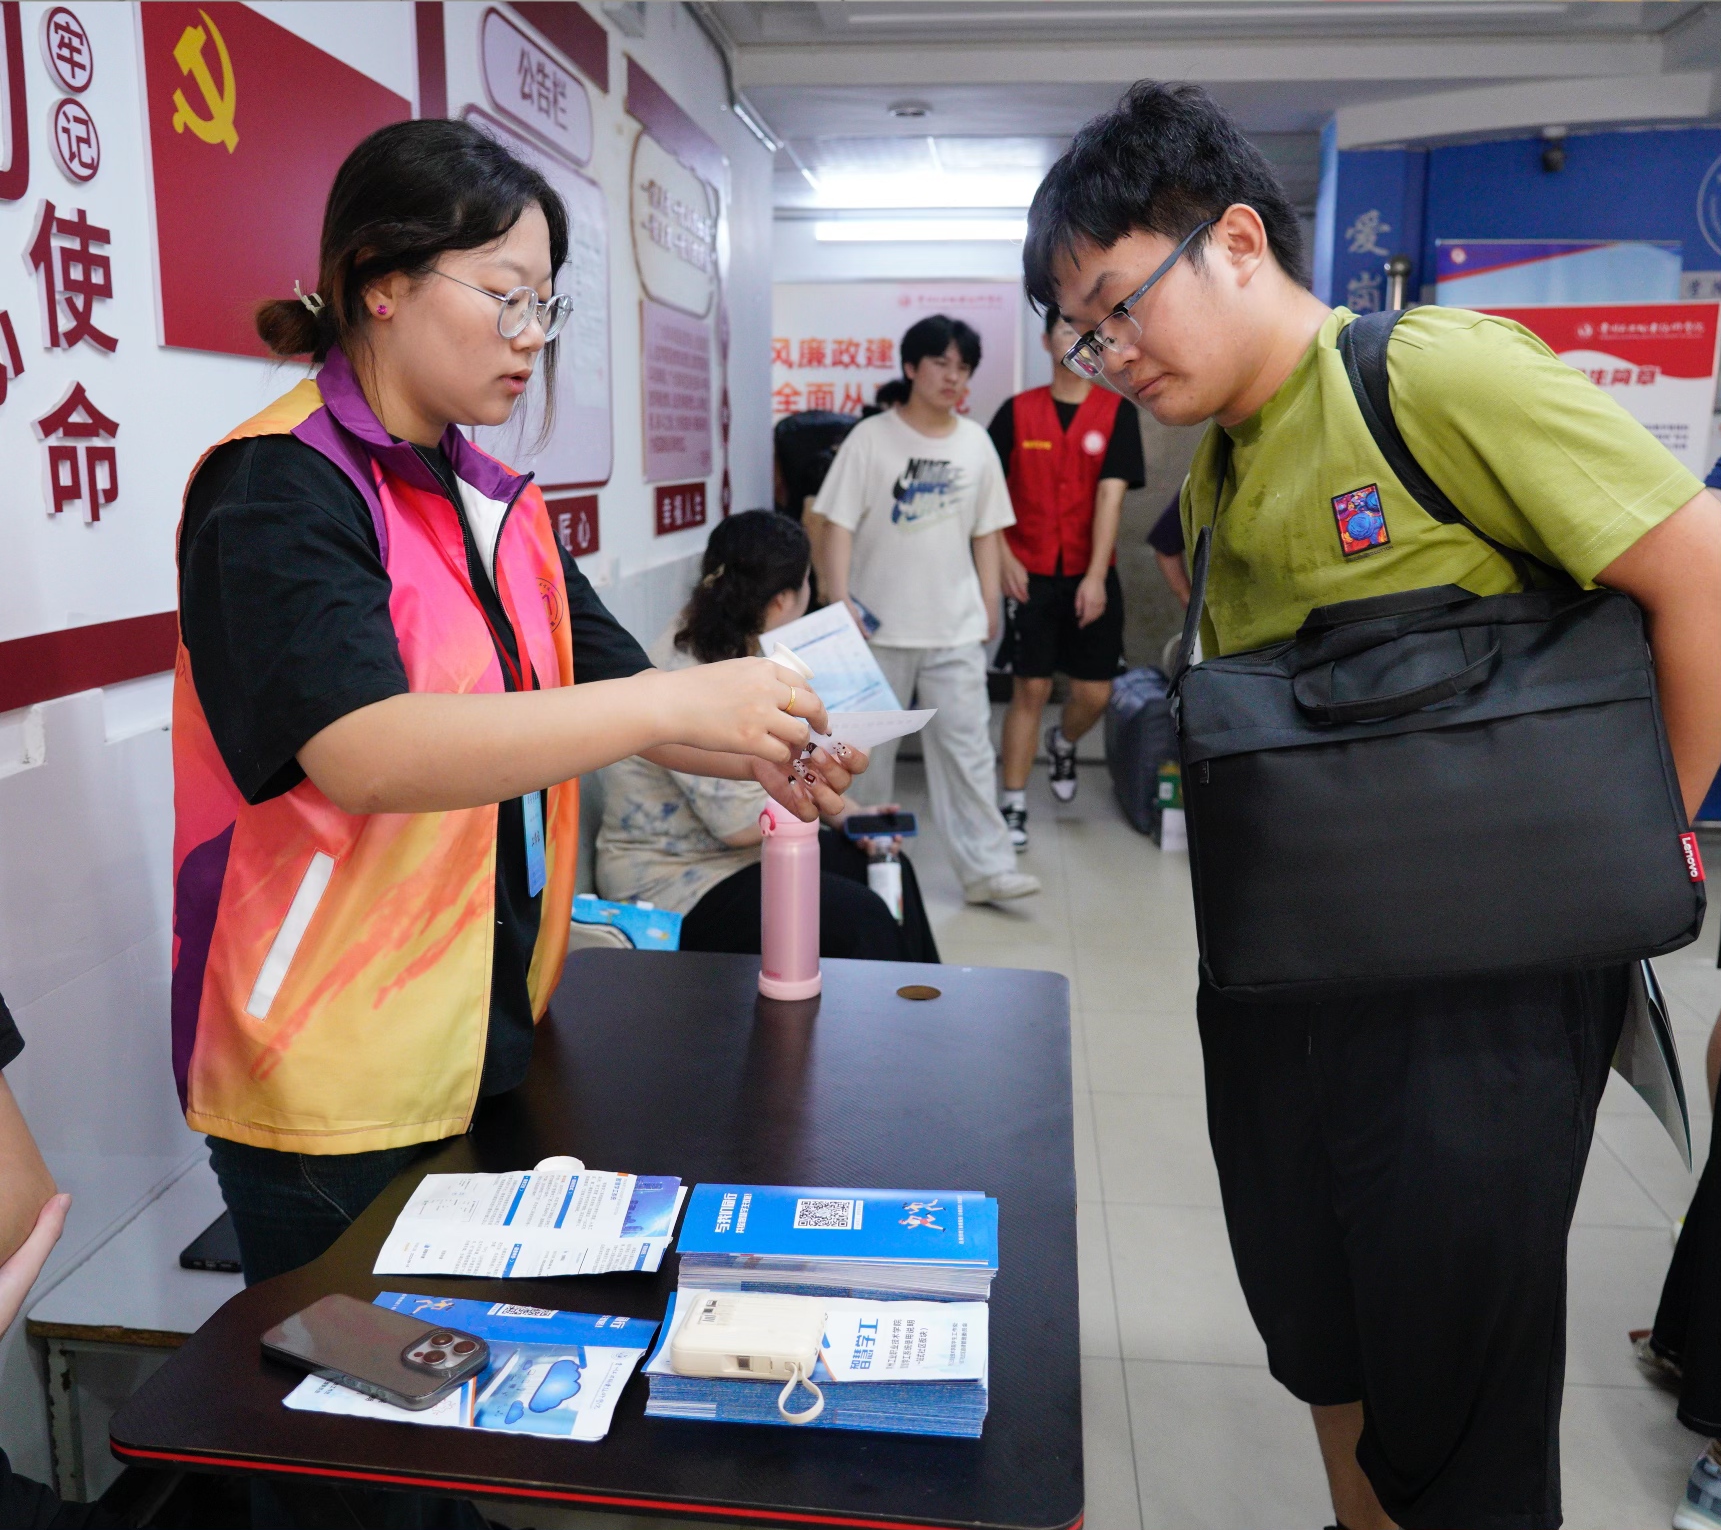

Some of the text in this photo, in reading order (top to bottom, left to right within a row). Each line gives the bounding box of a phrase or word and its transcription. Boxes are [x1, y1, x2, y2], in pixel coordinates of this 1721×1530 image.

[773, 381, 880, 417] 全面从
[1682, 836, 1698, 878] Lenovo
[850, 1318, 880, 1370] 智慧学工
